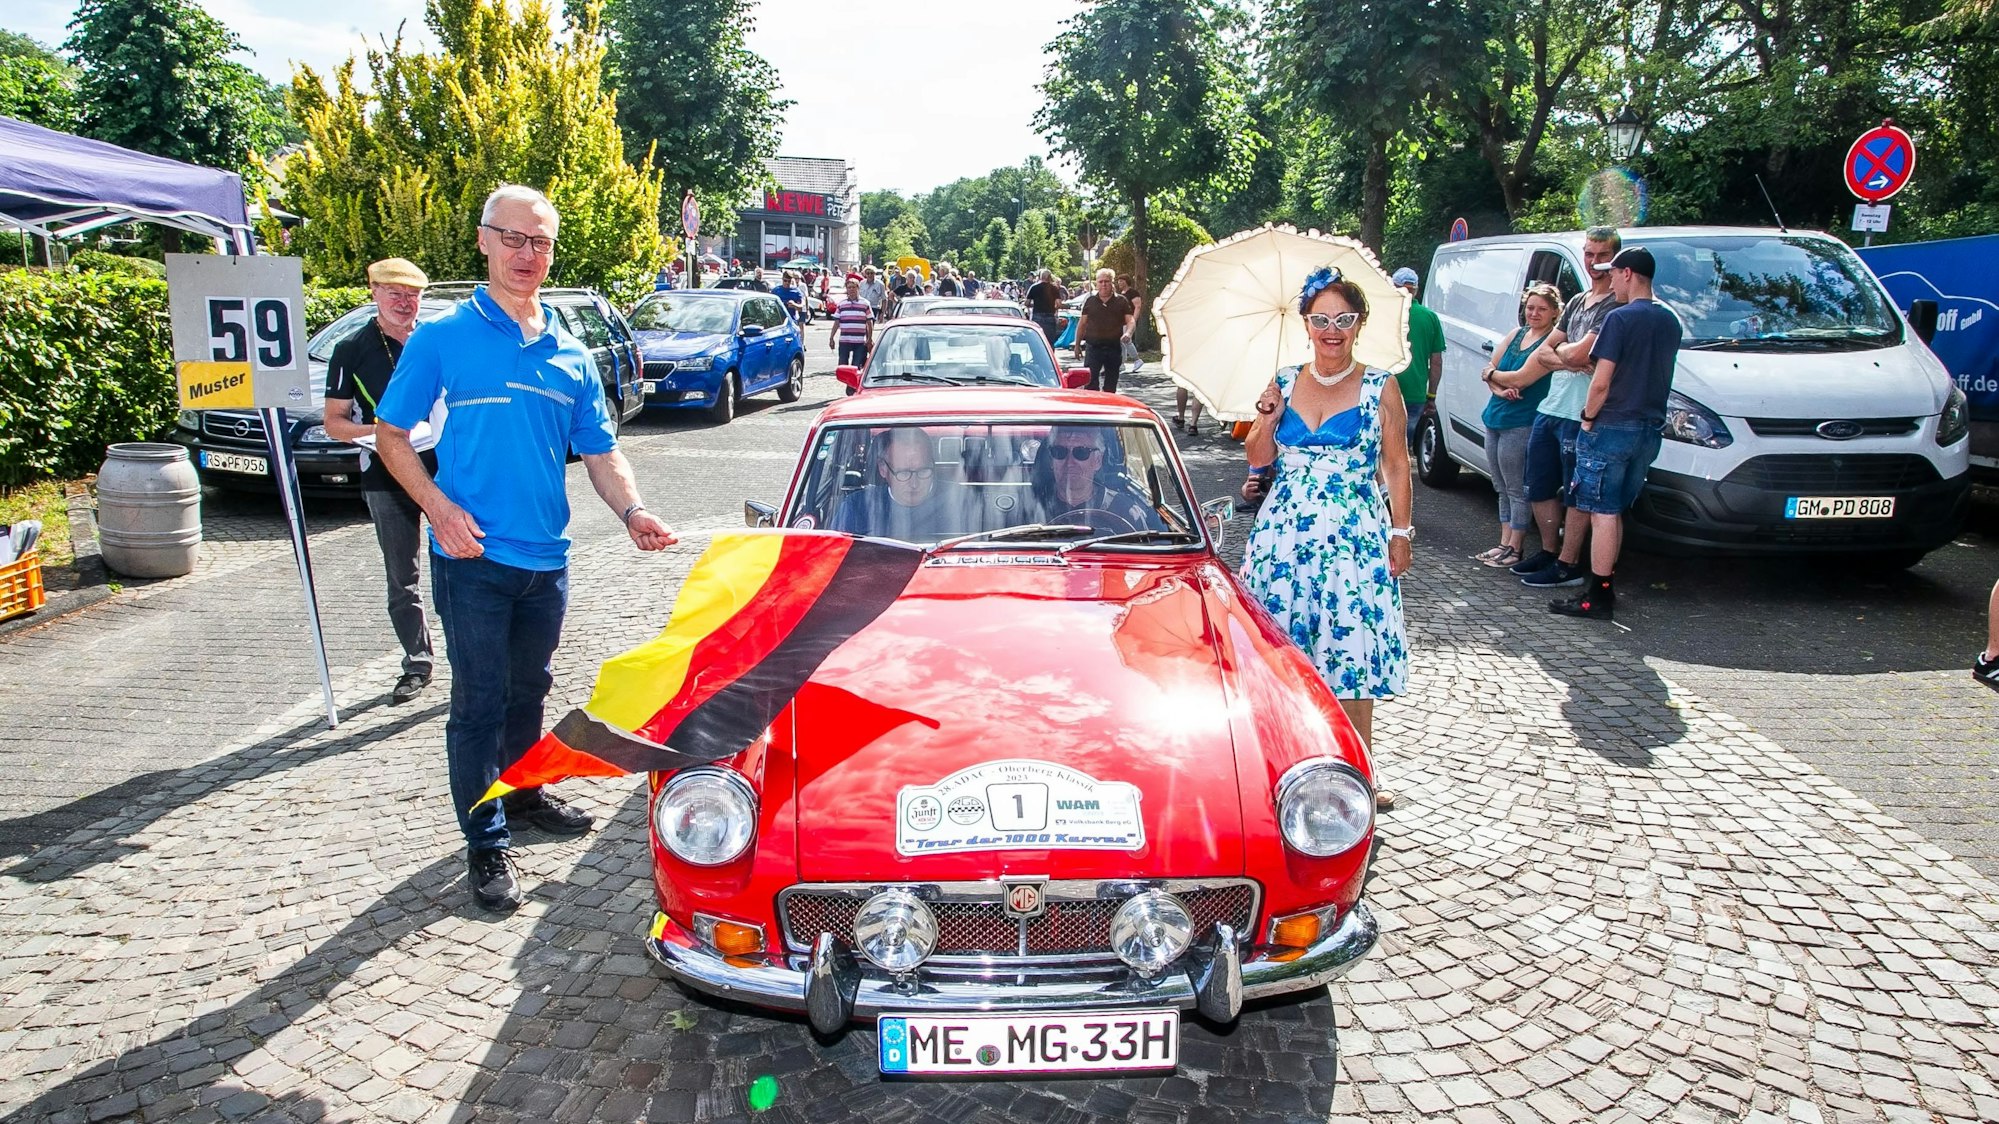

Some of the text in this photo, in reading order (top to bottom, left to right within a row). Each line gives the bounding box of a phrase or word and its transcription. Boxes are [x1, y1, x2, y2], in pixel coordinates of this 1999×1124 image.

[766, 191, 825, 215] REWE
[1960, 308, 1983, 331] GmbH
[208, 299, 293, 367] 59
[189, 372, 246, 400] Muster
[206, 452, 265, 472] RS PF 956
[1797, 499, 1892, 515] GM PD 808
[998, 765, 1053, 778] Oberberg
[1056, 770, 1094, 793] Klassik
[1006, 774, 1029, 782] 2023
[1012, 794, 1024, 819] 1
[1056, 799, 1100, 810] WAM
[1005, 833, 1051, 843] 1000
[1013, 888, 1036, 909] MG
[909, 1025, 971, 1065] ME
